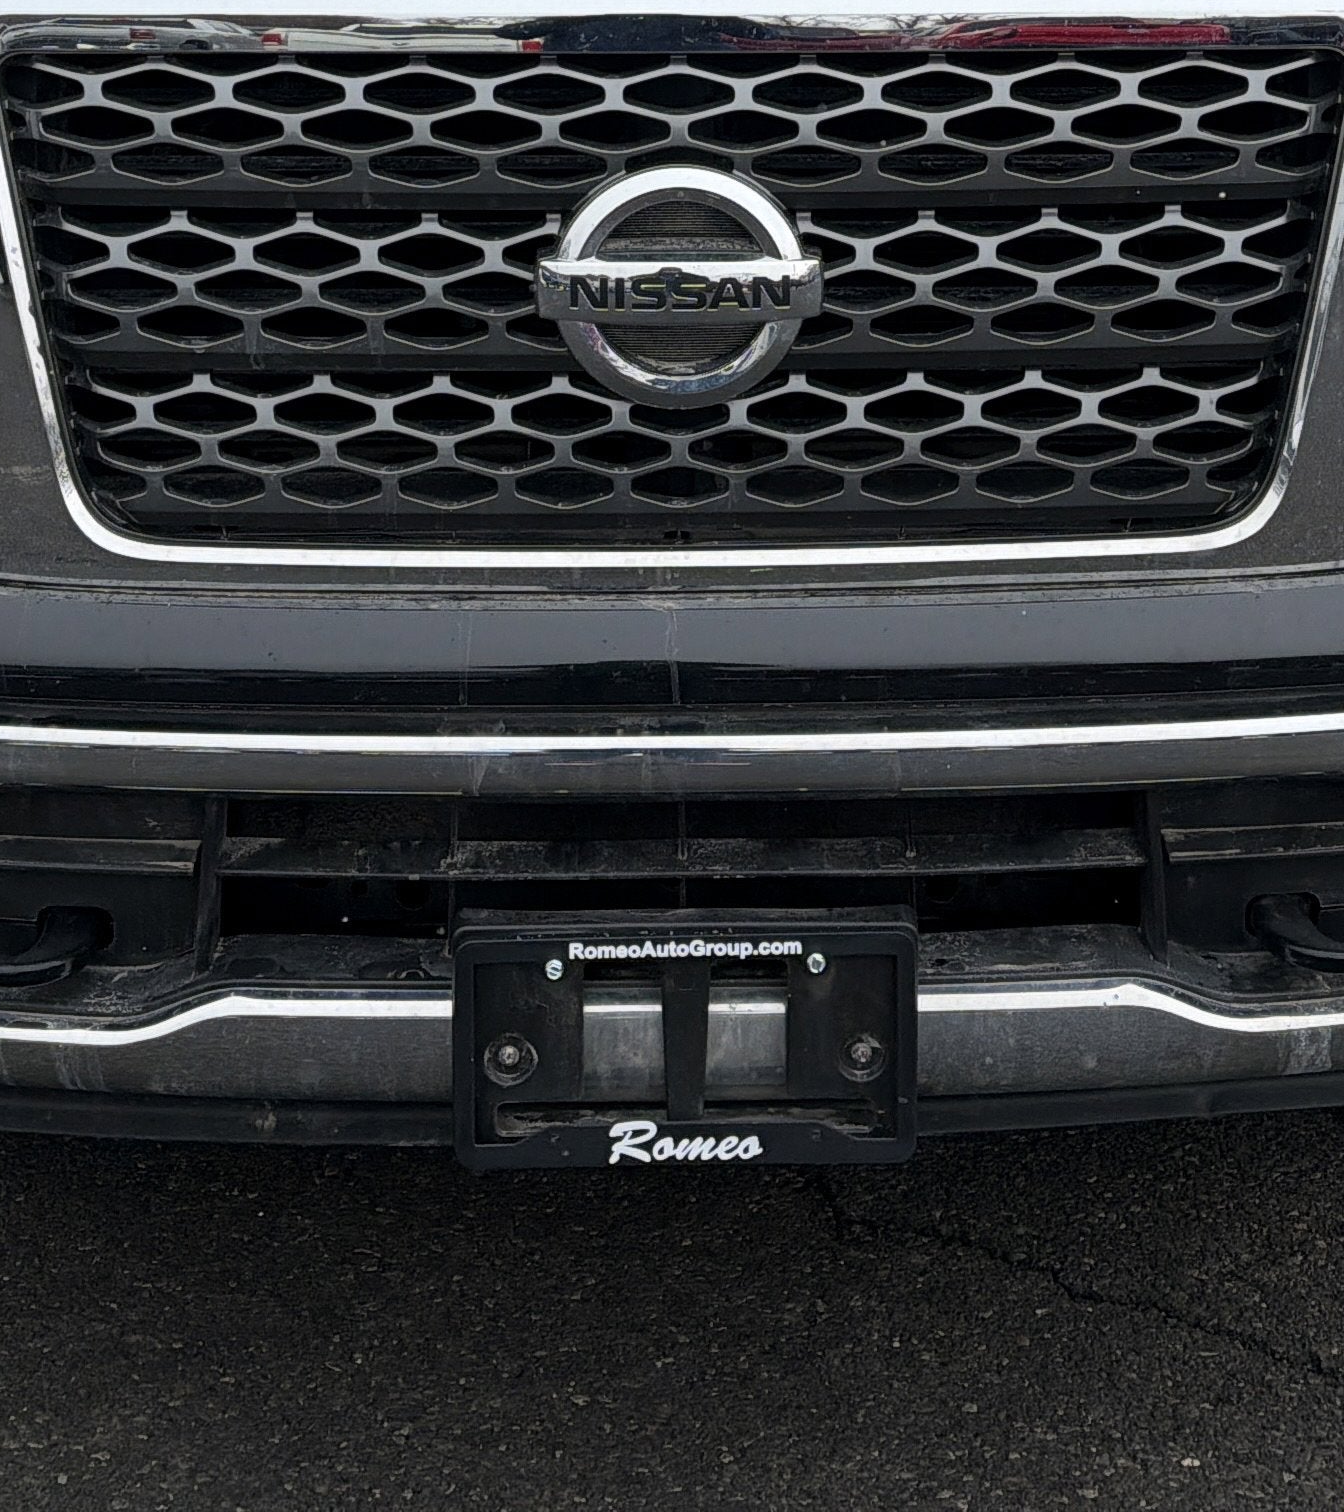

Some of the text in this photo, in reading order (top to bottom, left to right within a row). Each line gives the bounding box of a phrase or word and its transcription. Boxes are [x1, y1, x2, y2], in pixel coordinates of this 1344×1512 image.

[568, 274, 792, 312] NISSAN
[568, 939, 803, 961] RomeoAutoGroup.com
[608, 1120, 763, 1165] Romeo
